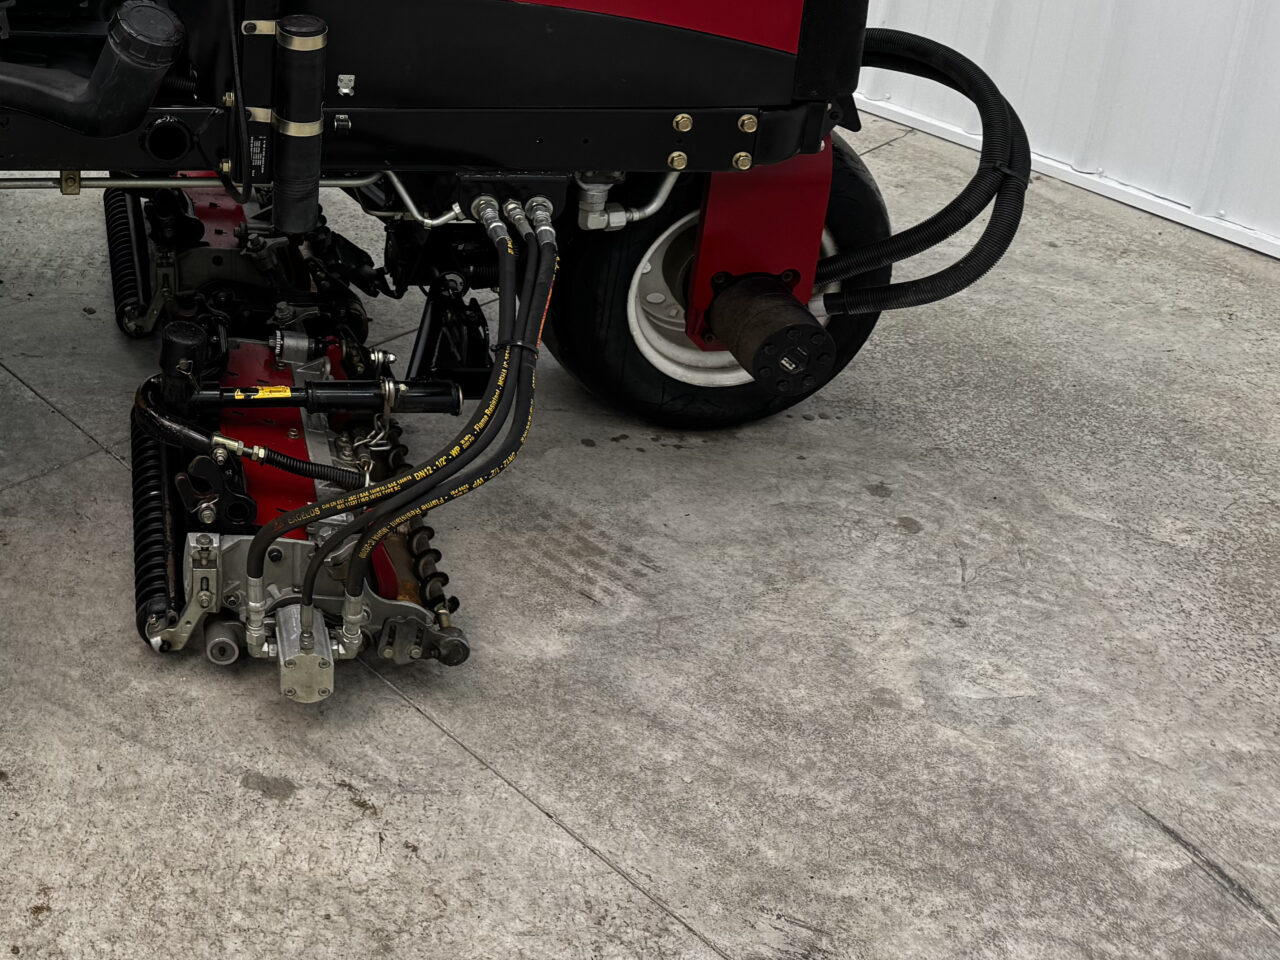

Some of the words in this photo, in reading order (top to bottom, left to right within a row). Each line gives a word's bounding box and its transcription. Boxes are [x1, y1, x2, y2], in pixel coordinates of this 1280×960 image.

[414, 466, 433, 481] DN12
[450, 445, 461, 457] WP
[474, 415, 489, 432] Flame
[421, 497, 445, 511] Flame
